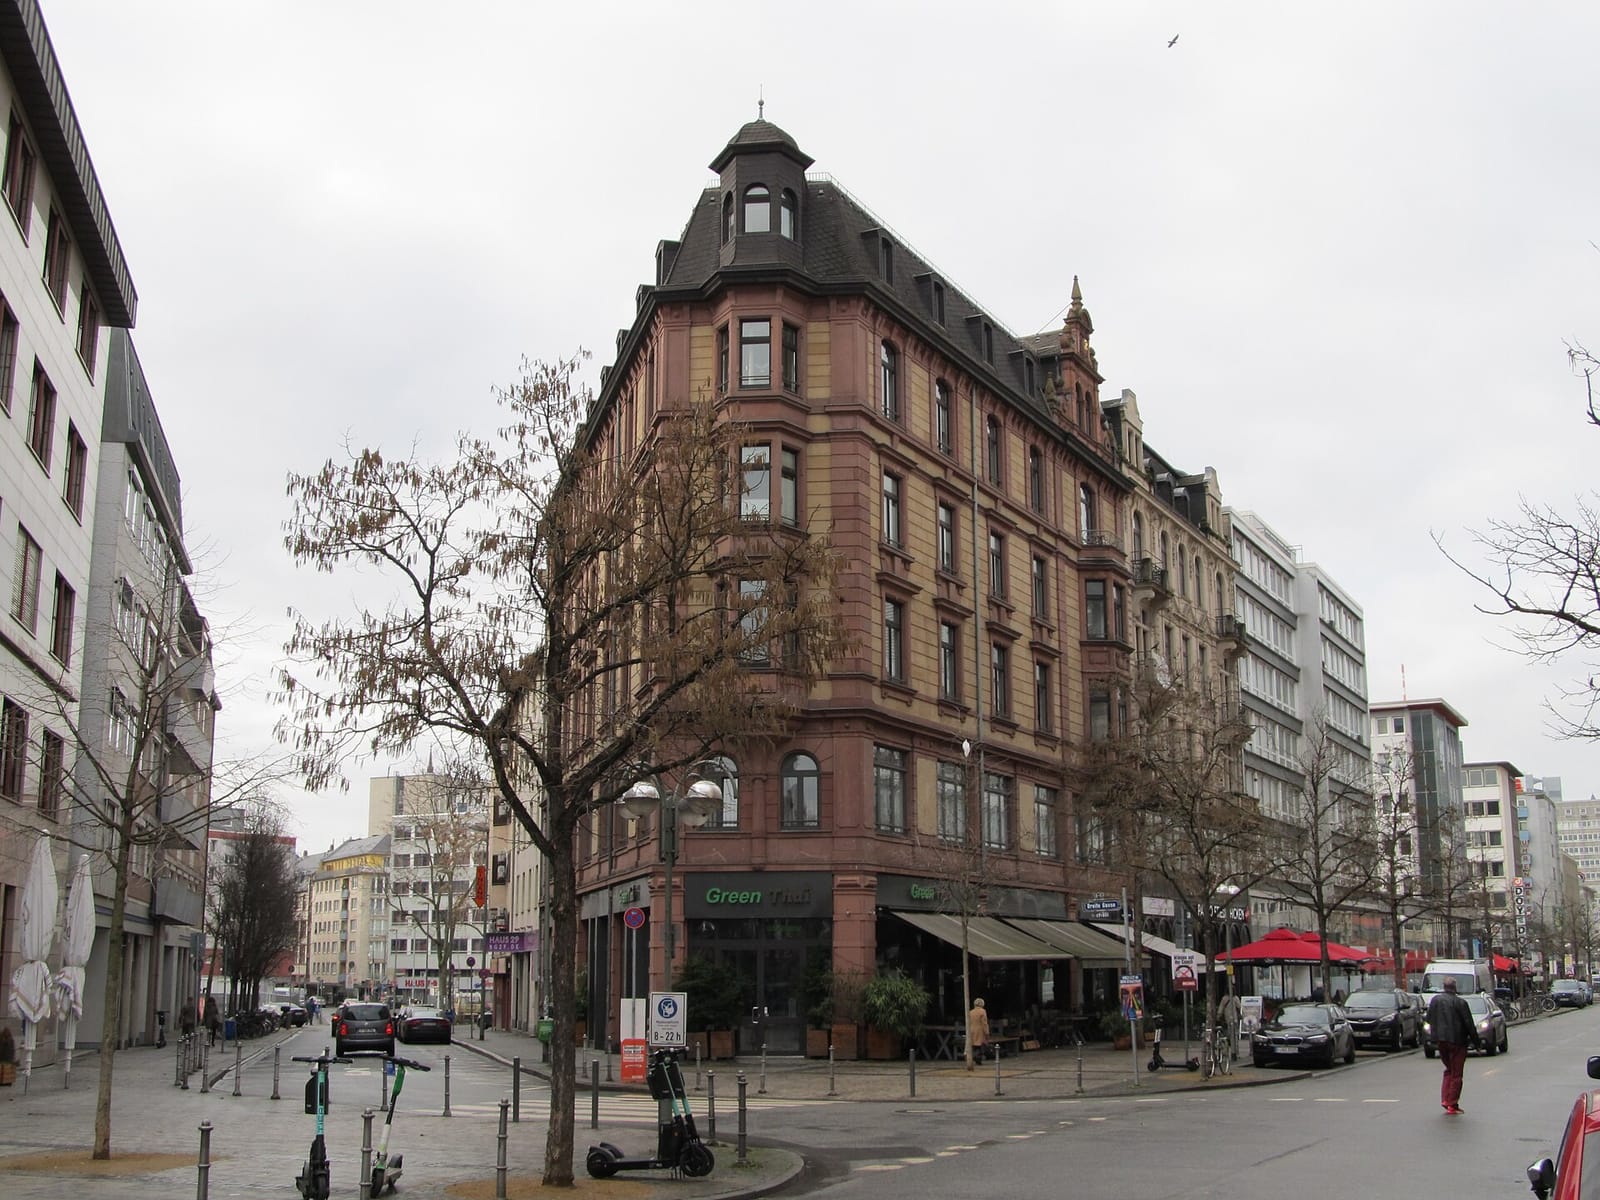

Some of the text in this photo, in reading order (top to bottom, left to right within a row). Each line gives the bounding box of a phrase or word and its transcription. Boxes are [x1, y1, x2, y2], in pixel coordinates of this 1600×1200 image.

[706, 887, 762, 905] Green
[910, 884, 935, 899] Green
[489, 935, 509, 944] HAUS
[654, 1031, 659, 1041] 8
[665, 1031, 675, 1041] 22
[676, 1031, 681, 1041] h
